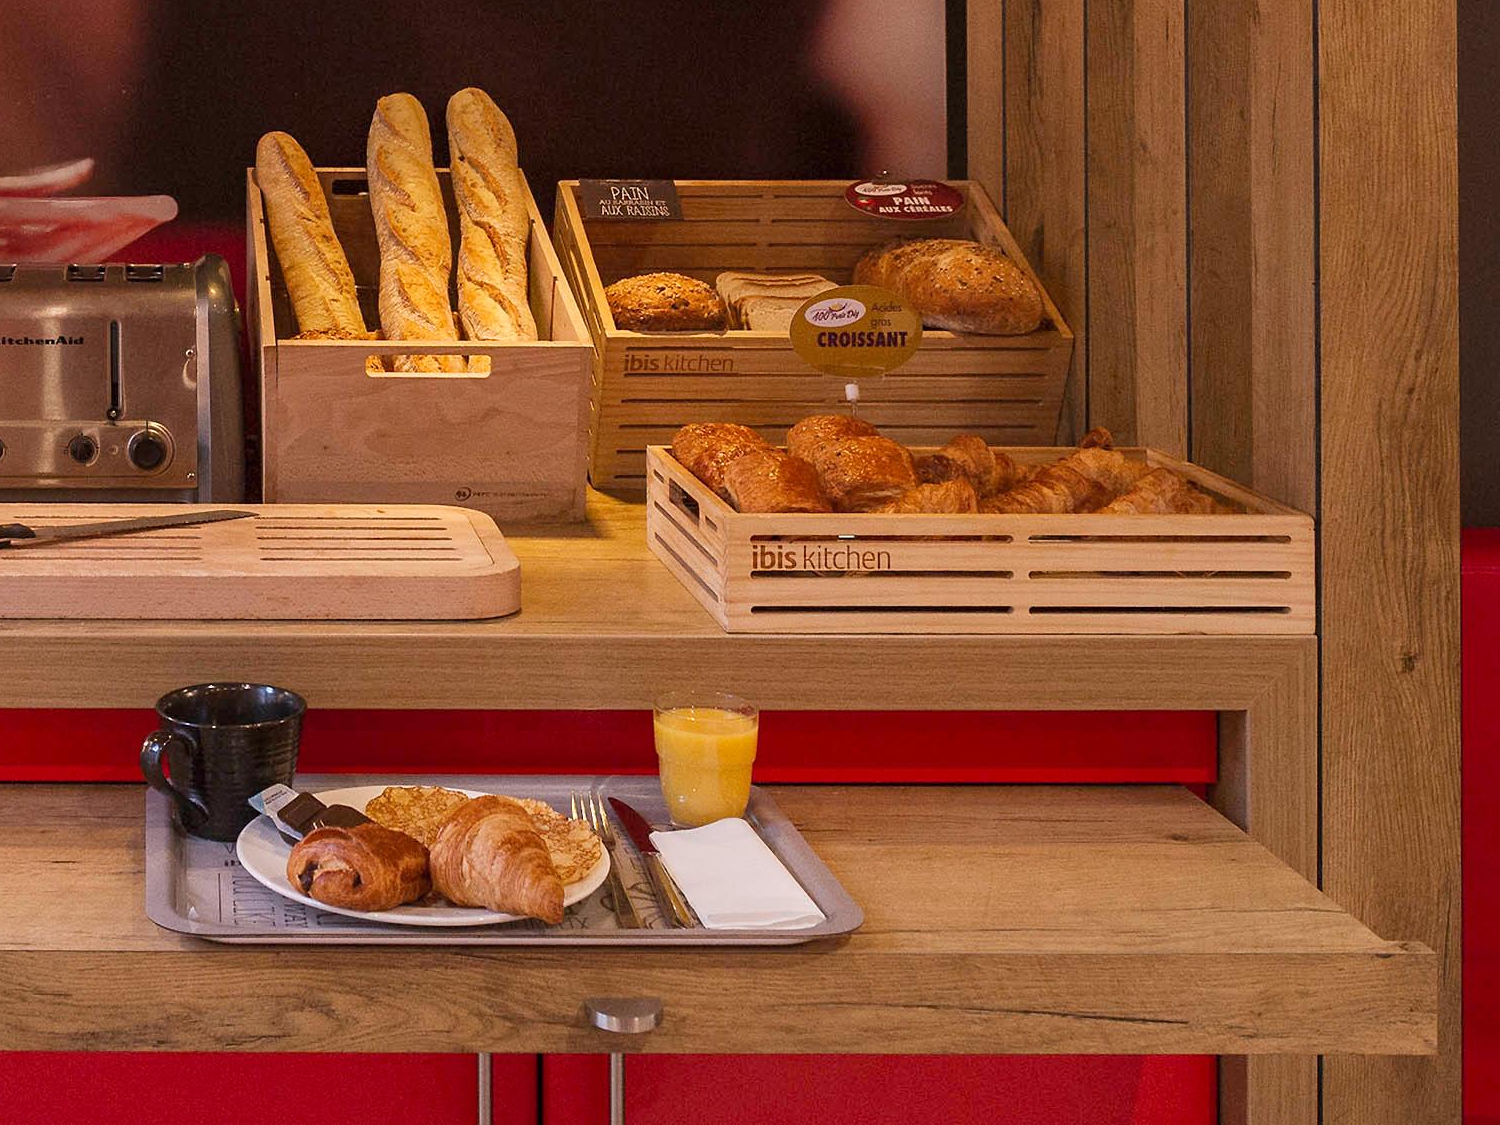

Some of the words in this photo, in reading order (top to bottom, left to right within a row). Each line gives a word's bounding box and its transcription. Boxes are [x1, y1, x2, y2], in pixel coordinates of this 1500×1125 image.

[611, 187, 649, 200] PAIN
[893, 196, 930, 206] PAIN
[601, 205, 624, 216] AUX
[626, 206, 670, 217] RAISINS
[903, 205, 953, 213] CÉRÉALES
[871, 302, 902, 312] Acides
[870, 318, 892, 330] gras
[817, 331, 908, 348] CROISSANT
[623, 354, 660, 372] ibis
[663, 354, 734, 372] kitchen
[751, 545, 797, 571] ibis
[803, 545, 891, 571] kitchen
